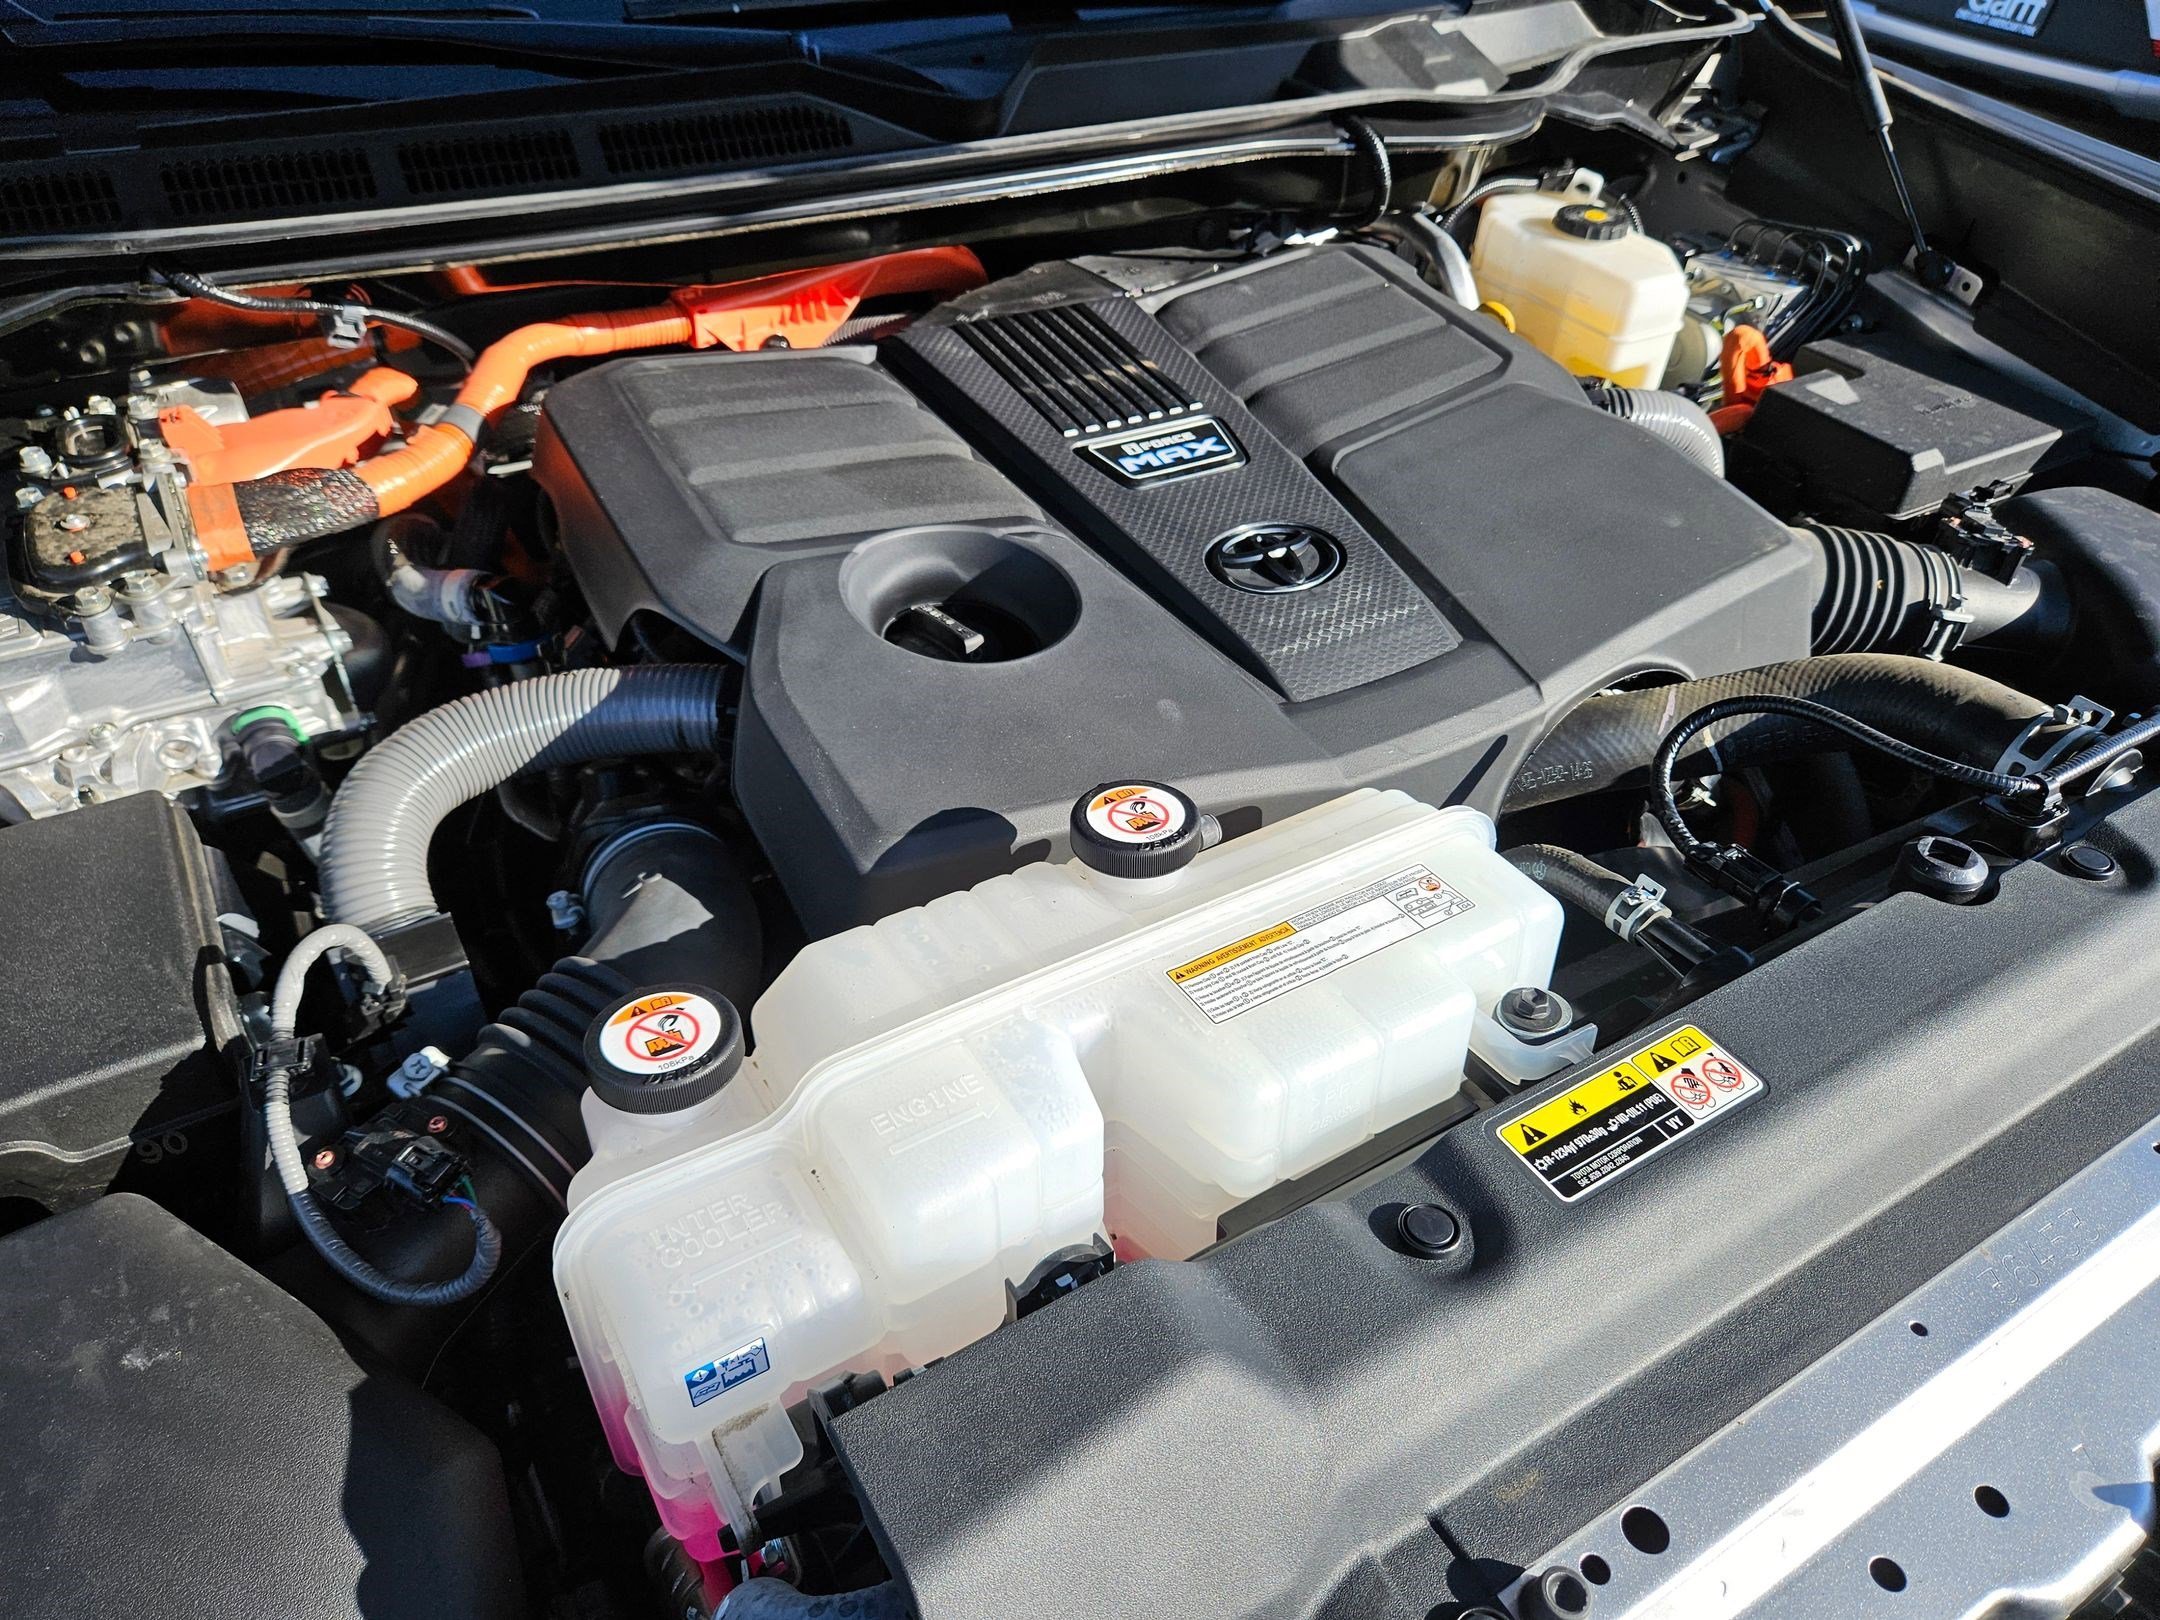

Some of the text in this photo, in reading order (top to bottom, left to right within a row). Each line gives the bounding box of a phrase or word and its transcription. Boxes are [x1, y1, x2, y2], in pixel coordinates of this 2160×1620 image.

[1118, 436, 1229, 473] MAX
[1184, 926, 1290, 975] WARNING AVERTISSEMENT ADVERTENCIA
[658, 1055, 695, 1071] 108kPa
[870, 1074, 985, 1136] ENGINE
[1647, 1092, 1667, 1110] (POE)
[1665, 1115, 1684, 1130] VY
[136, 1128, 188, 1165] 90
[1570, 1137, 1643, 1181] TOYOTA MOTOR CORPORATION
[1577, 1177, 1590, 1188] SAE
[650, 1193, 753, 1250] INTER
[661, 1201, 789, 1268] COOLER
